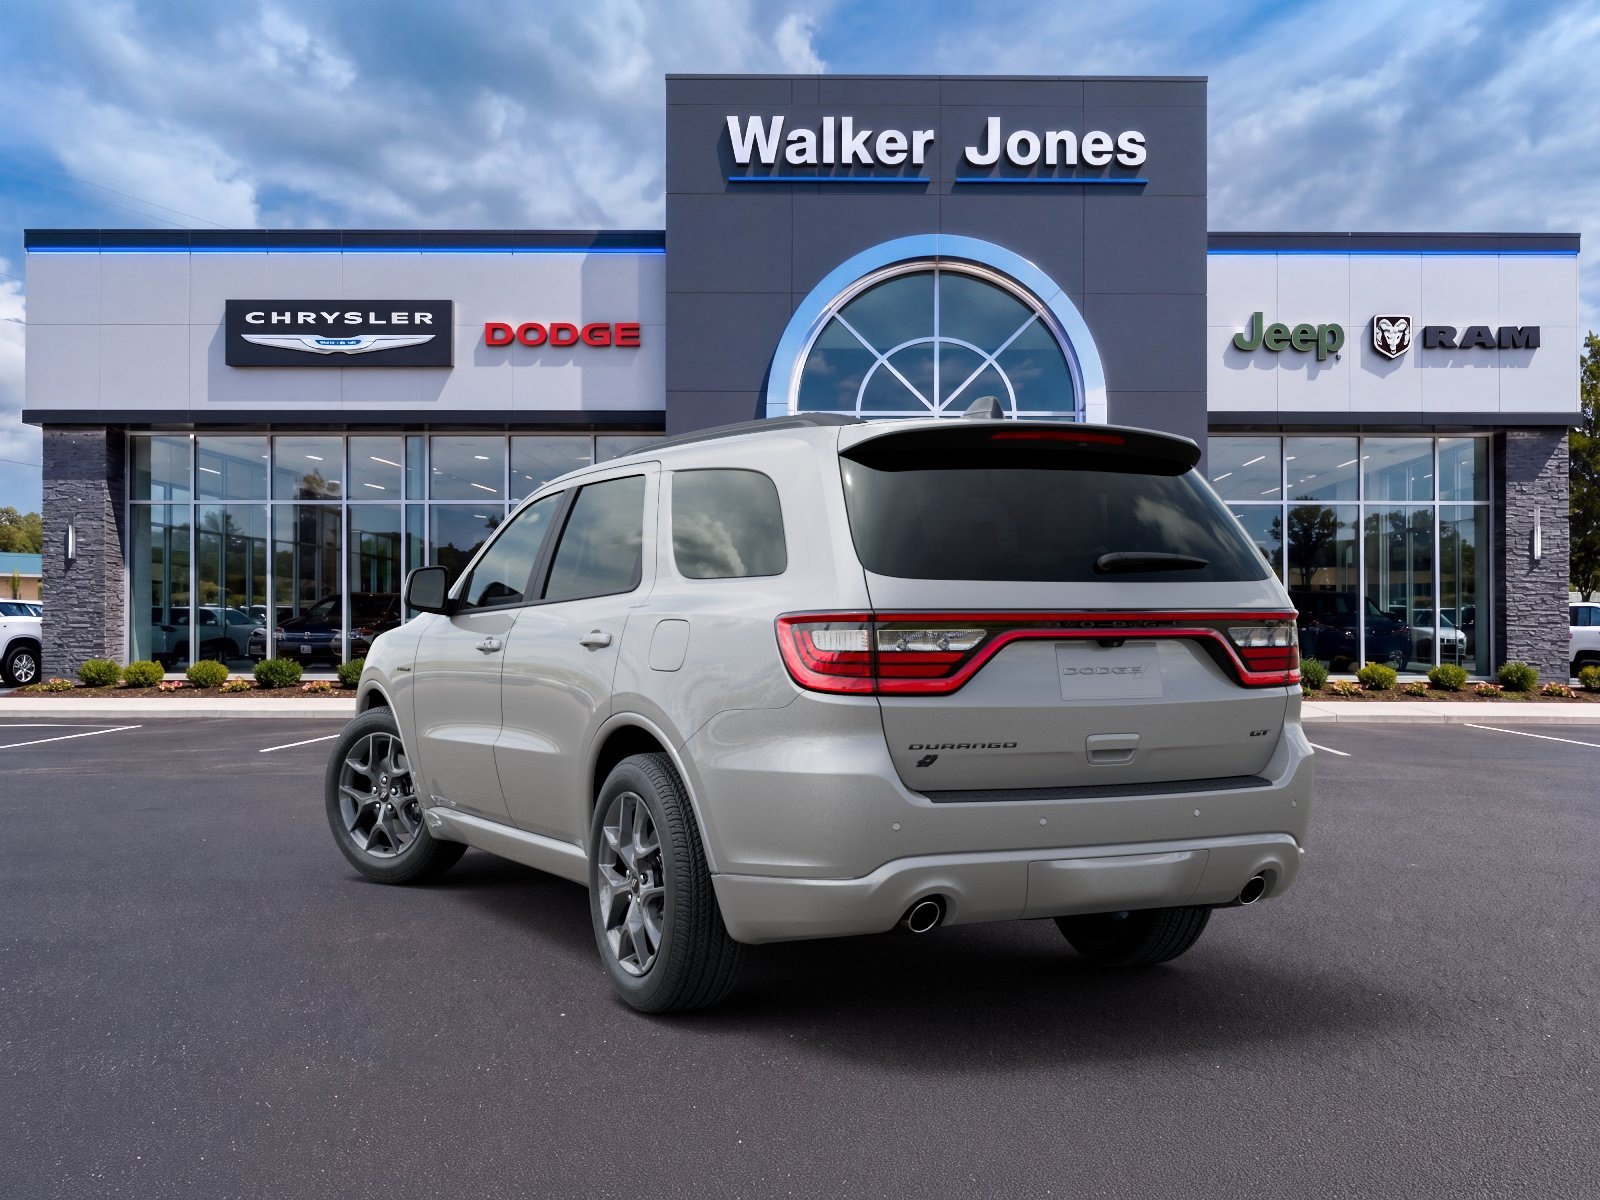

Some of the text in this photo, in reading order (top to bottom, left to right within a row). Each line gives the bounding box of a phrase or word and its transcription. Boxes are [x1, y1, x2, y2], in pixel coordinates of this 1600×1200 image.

[726, 115, 1147, 166] Walker Jones
[245, 311, 433, 325] CHRYSLER
[485, 322, 641, 347] DODGE
[1233, 311, 1345, 360] Jeep
[1424, 325, 1541, 348] RAM
[1062, 666, 1144, 676] DODGE
[908, 742, 1018, 750] DURANGO
